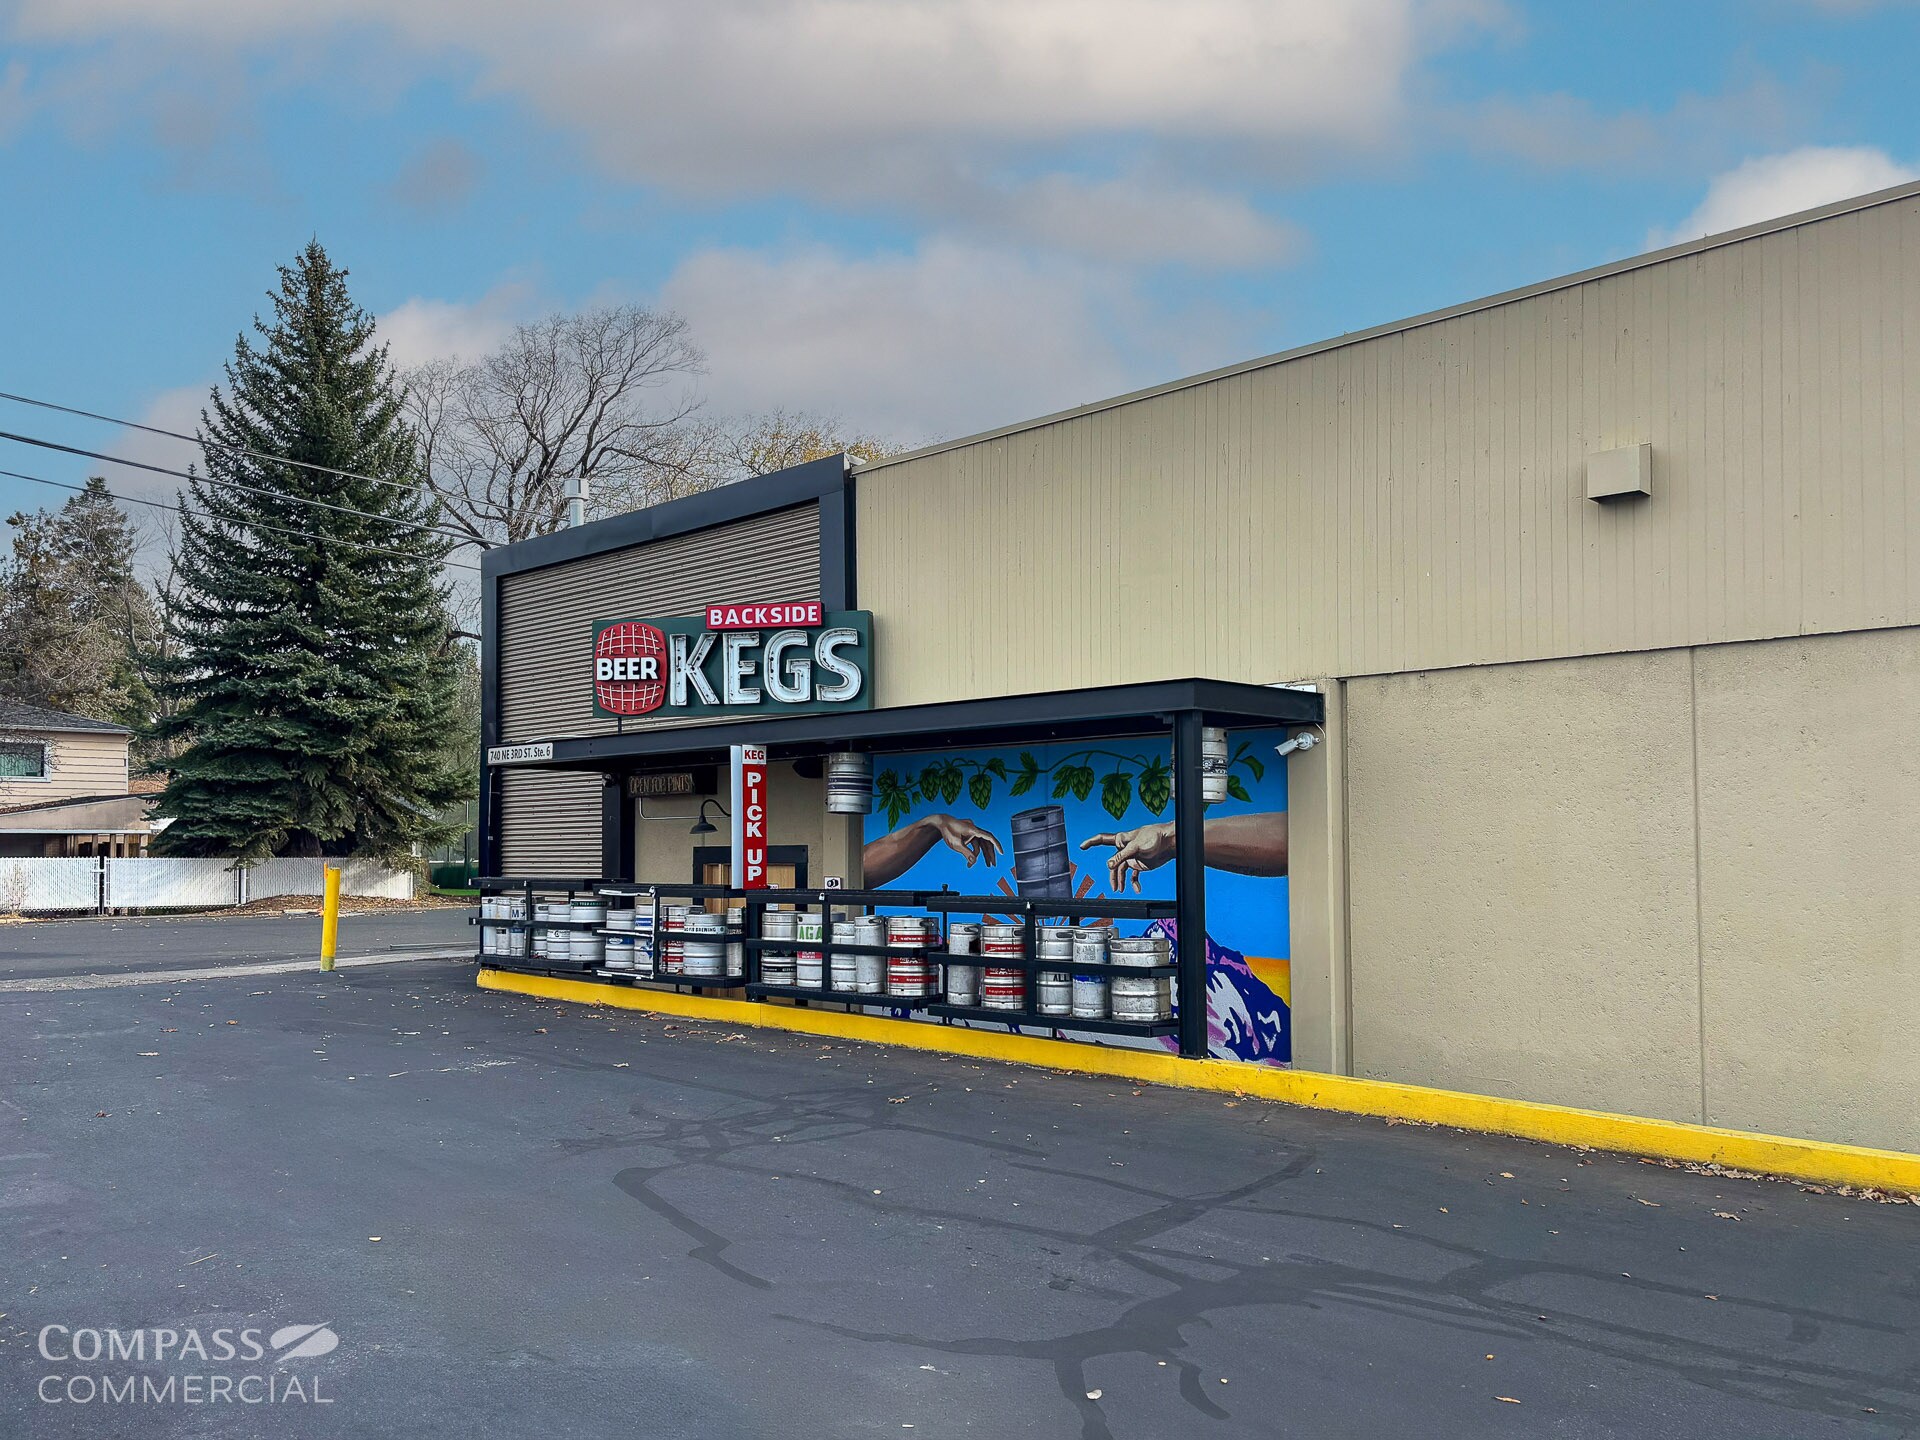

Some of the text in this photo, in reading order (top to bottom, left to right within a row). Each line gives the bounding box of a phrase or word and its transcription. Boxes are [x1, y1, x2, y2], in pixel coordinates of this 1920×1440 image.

[710, 604, 818, 626] BACKSIDE
[596, 656, 659, 681] BEER
[669, 627, 862, 706] KEGS
[490, 745, 551, 760] 740 NE 3RD ST. Ste. 6
[744, 749, 765, 760] KEG
[746, 771, 763, 881] PICK UP
